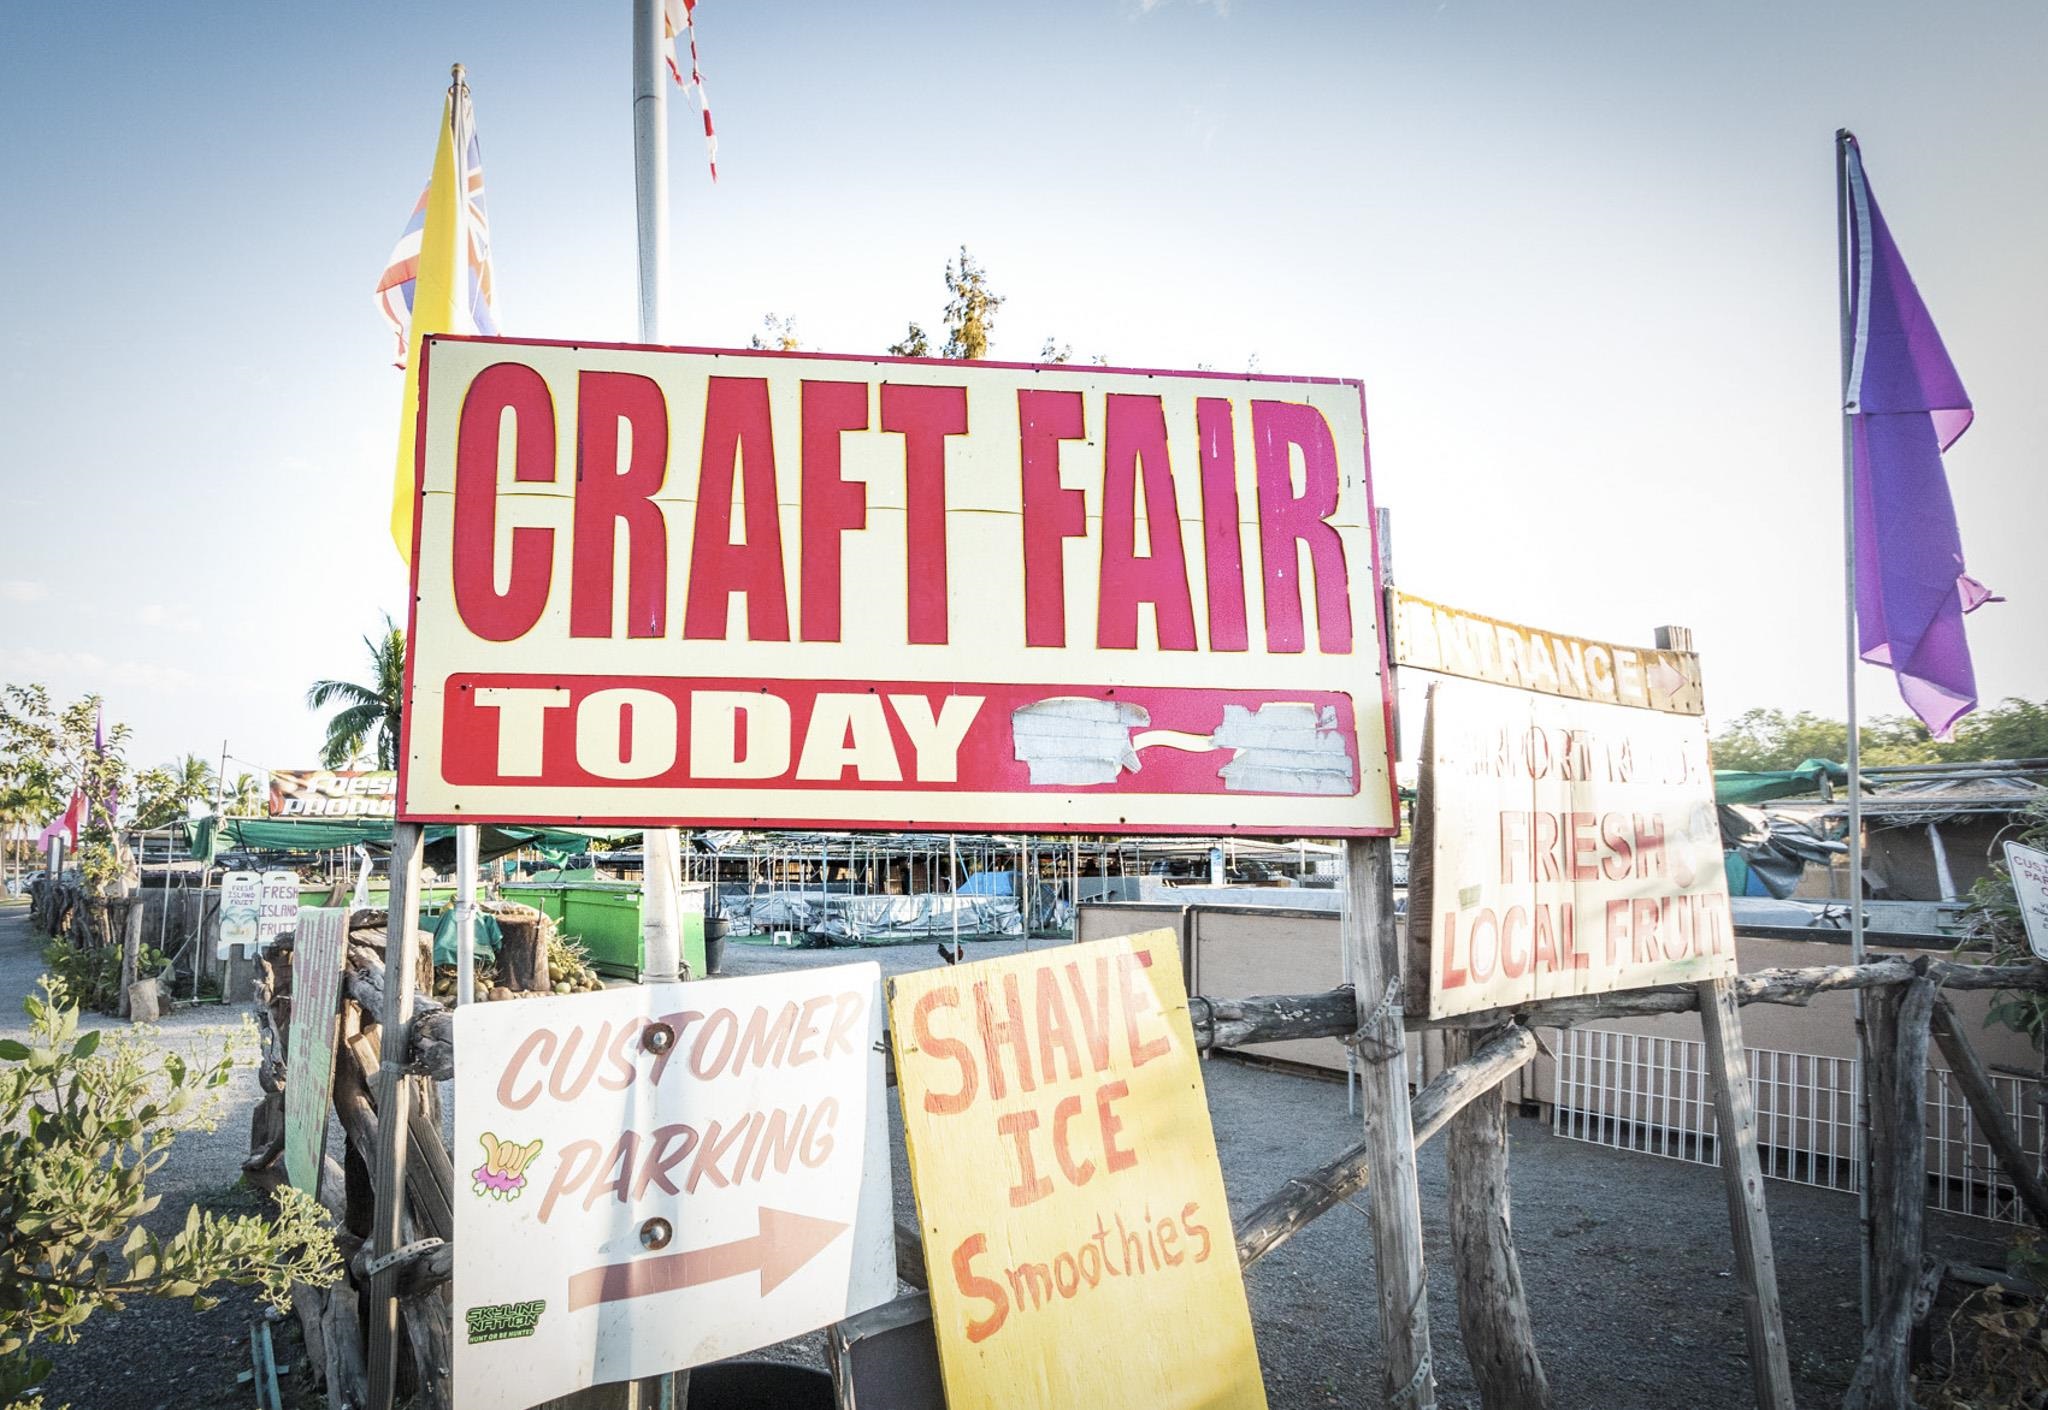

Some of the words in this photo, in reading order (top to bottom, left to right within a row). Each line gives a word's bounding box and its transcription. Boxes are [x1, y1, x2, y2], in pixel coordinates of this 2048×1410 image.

[453, 362, 968, 646] CRAFT
[1017, 387, 1353, 655] FAIR
[474, 686, 985, 782] TODAY
[263, 886, 299, 899] FRESH
[1499, 810, 1666, 885] FRESH
[260, 904, 298, 917] ISLAND
[1442, 902, 1590, 990] LOCAL
[1605, 892, 1724, 967] FRUIT
[496, 991, 865, 1111] CUSTOMER
[912, 949, 1171, 1116] SHAVE
[537, 1096, 839, 1225] PARKING
[997, 1079, 1139, 1208] ICE
[467, 1300, 545, 1322] SKYLINE
[951, 1200, 1212, 1343] Smoothies
[468, 1314, 538, 1333] NATION
